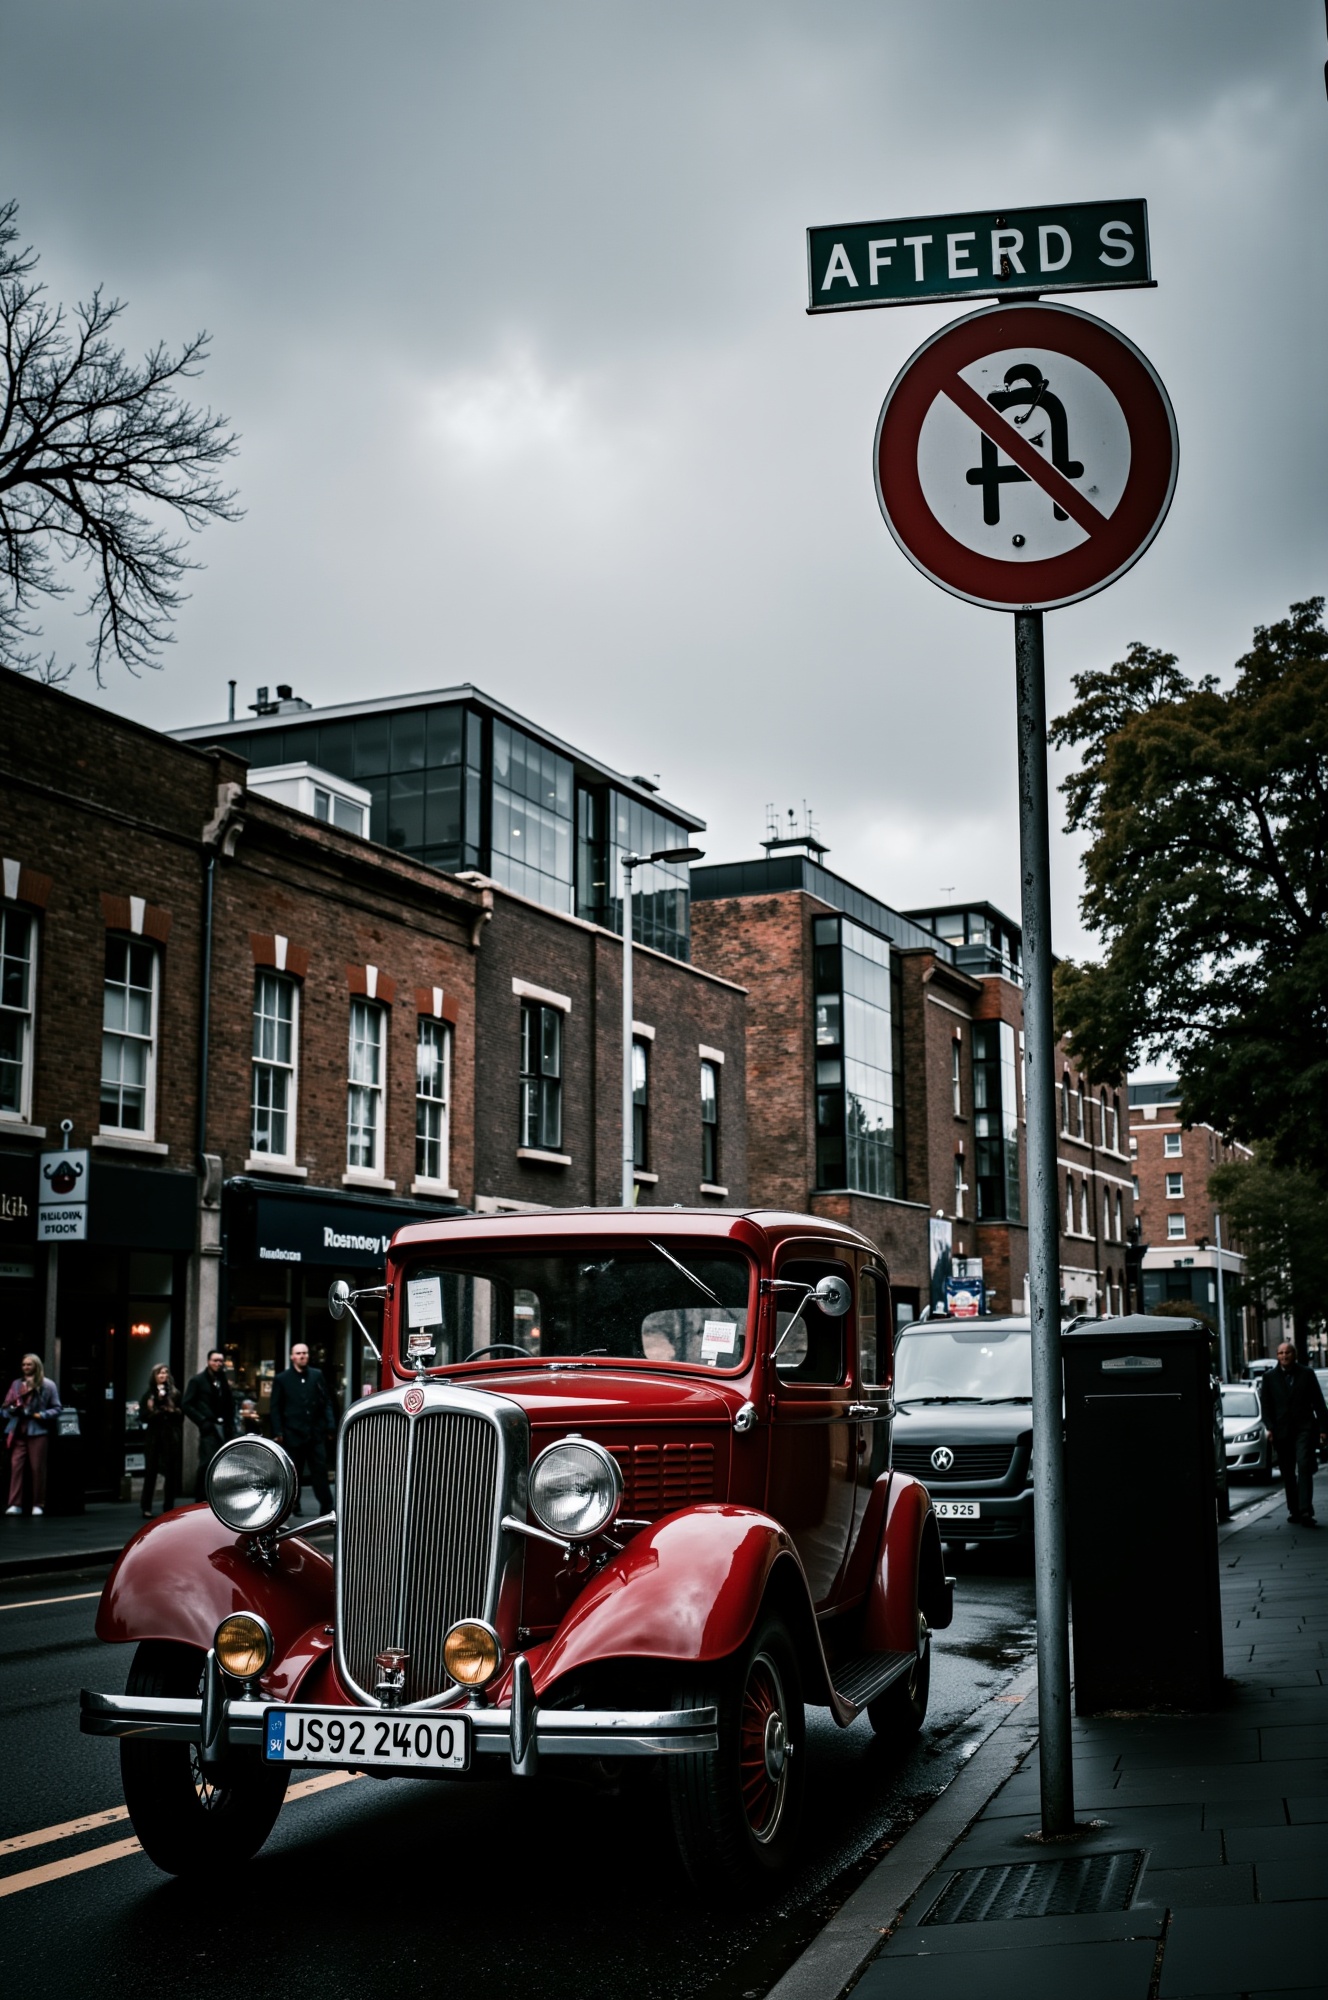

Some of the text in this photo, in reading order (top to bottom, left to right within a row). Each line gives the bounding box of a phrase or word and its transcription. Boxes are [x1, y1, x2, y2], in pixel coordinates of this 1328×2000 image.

[820, 220, 1135, 291] AFTERD S
[952, 1504, 974, 1516] 925
[286, 1718, 454, 1758] JS92 2400
